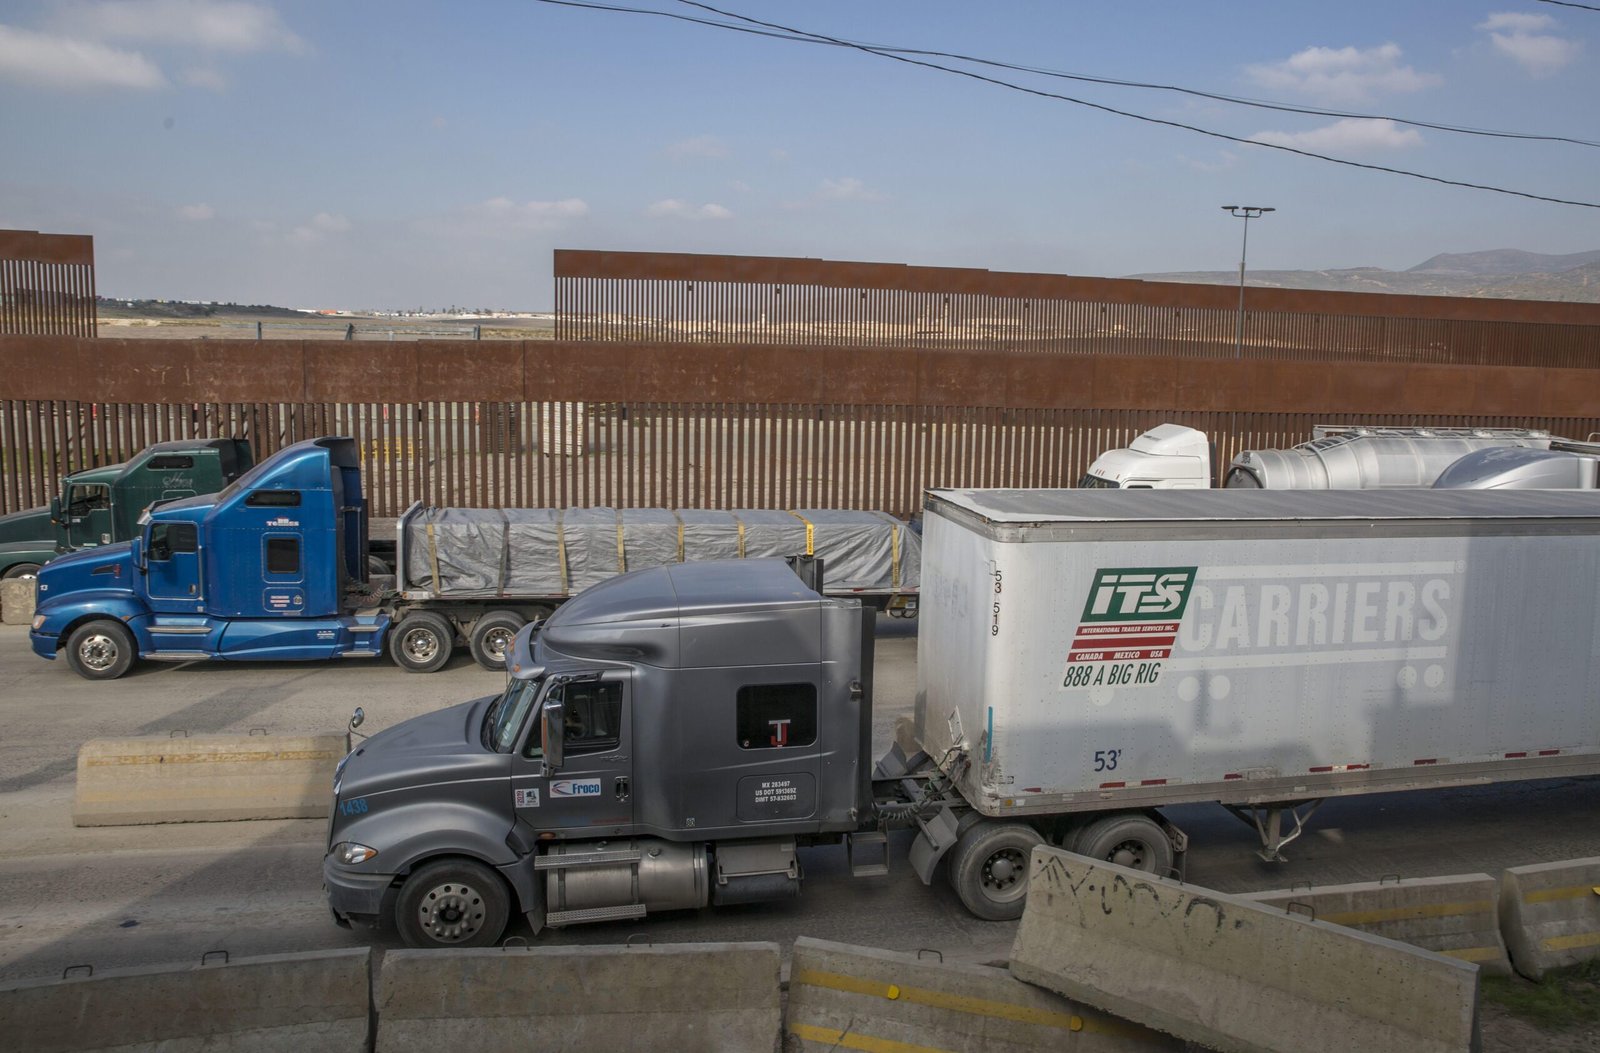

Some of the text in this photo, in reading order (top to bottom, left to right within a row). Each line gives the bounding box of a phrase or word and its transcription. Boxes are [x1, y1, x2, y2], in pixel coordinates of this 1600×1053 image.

[1179, 579, 1451, 651] CARRIERS
[1075, 650, 1164, 661] CANADA MEXICO USA
[1063, 662, 1161, 688] 888 A BIG RIG
[572, 783, 599, 794] Froco
[340, 799, 369, 816] 1438
